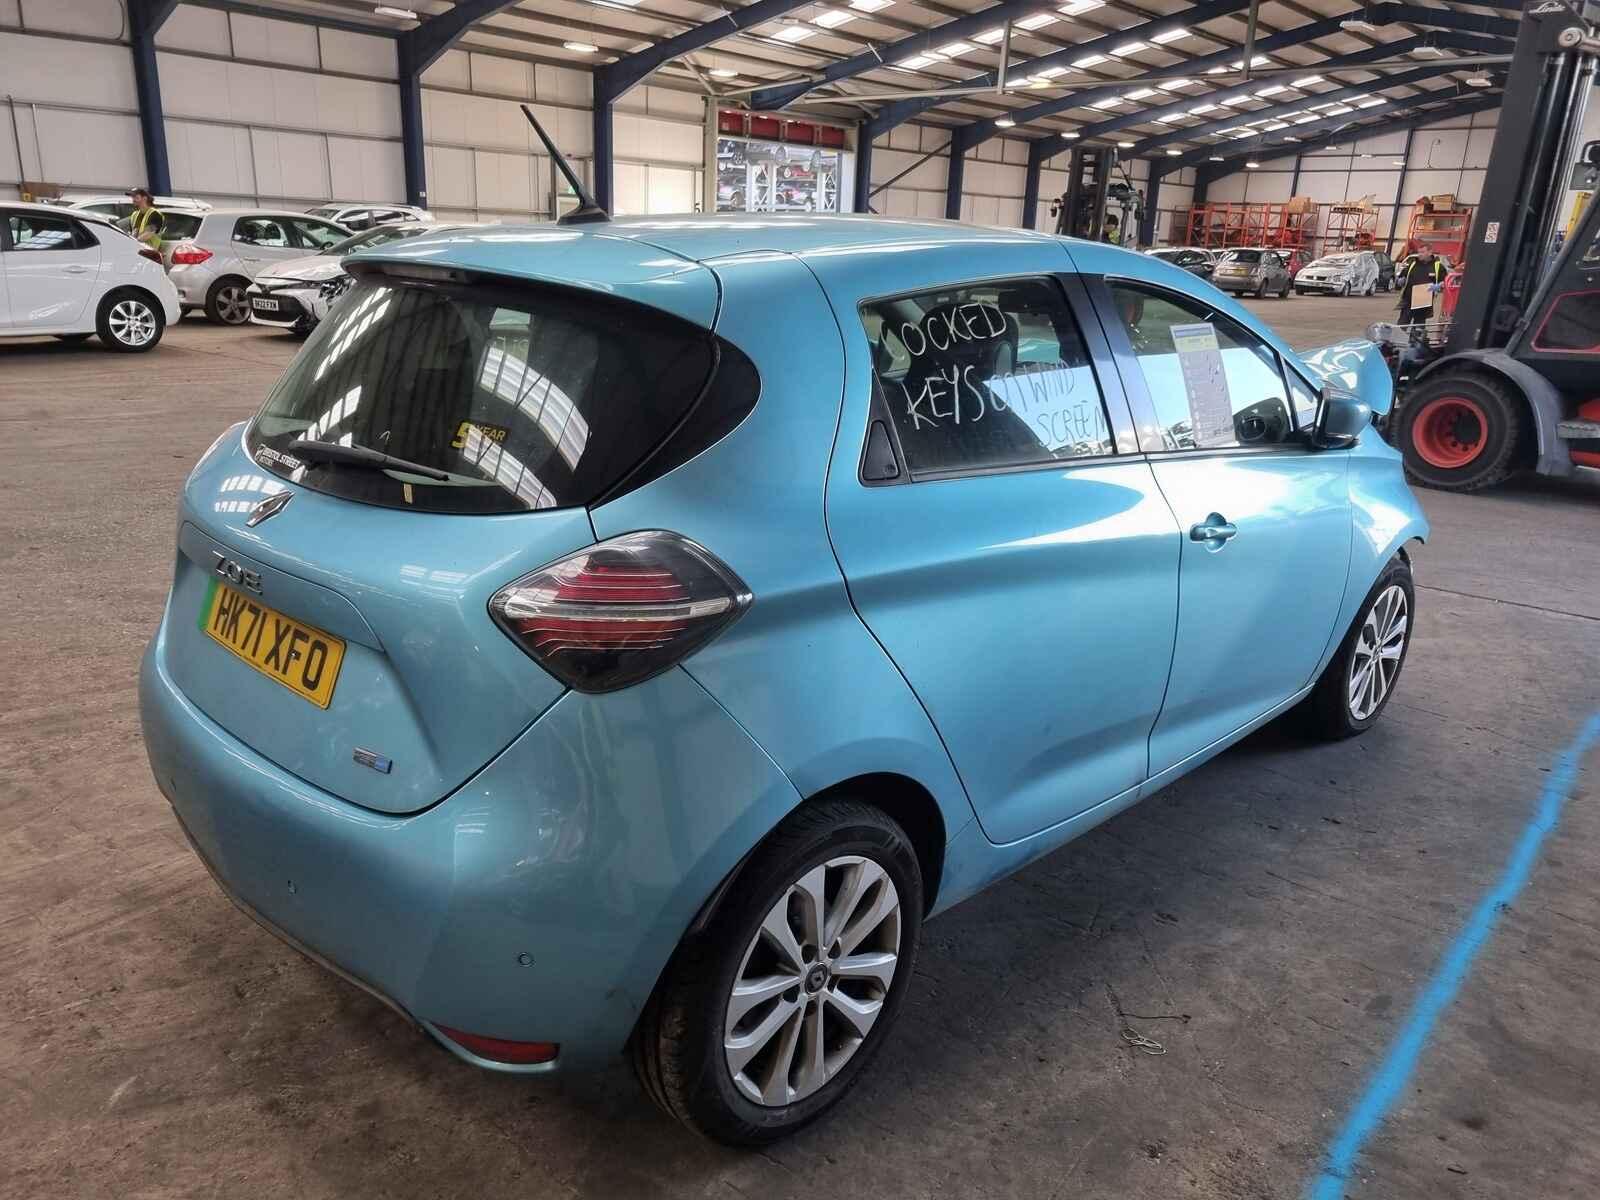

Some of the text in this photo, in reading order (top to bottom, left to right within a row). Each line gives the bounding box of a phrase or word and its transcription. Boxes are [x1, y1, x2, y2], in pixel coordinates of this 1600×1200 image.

[901, 364, 985, 431] KEYS
[476, 424, 506, 442] YEAR
[1036, 400, 1106, 447] SCREEN
[279, 454, 301, 469] STREET
[212, 550, 264, 595] ZOE
[213, 587, 329, 692] HK71 XFO
